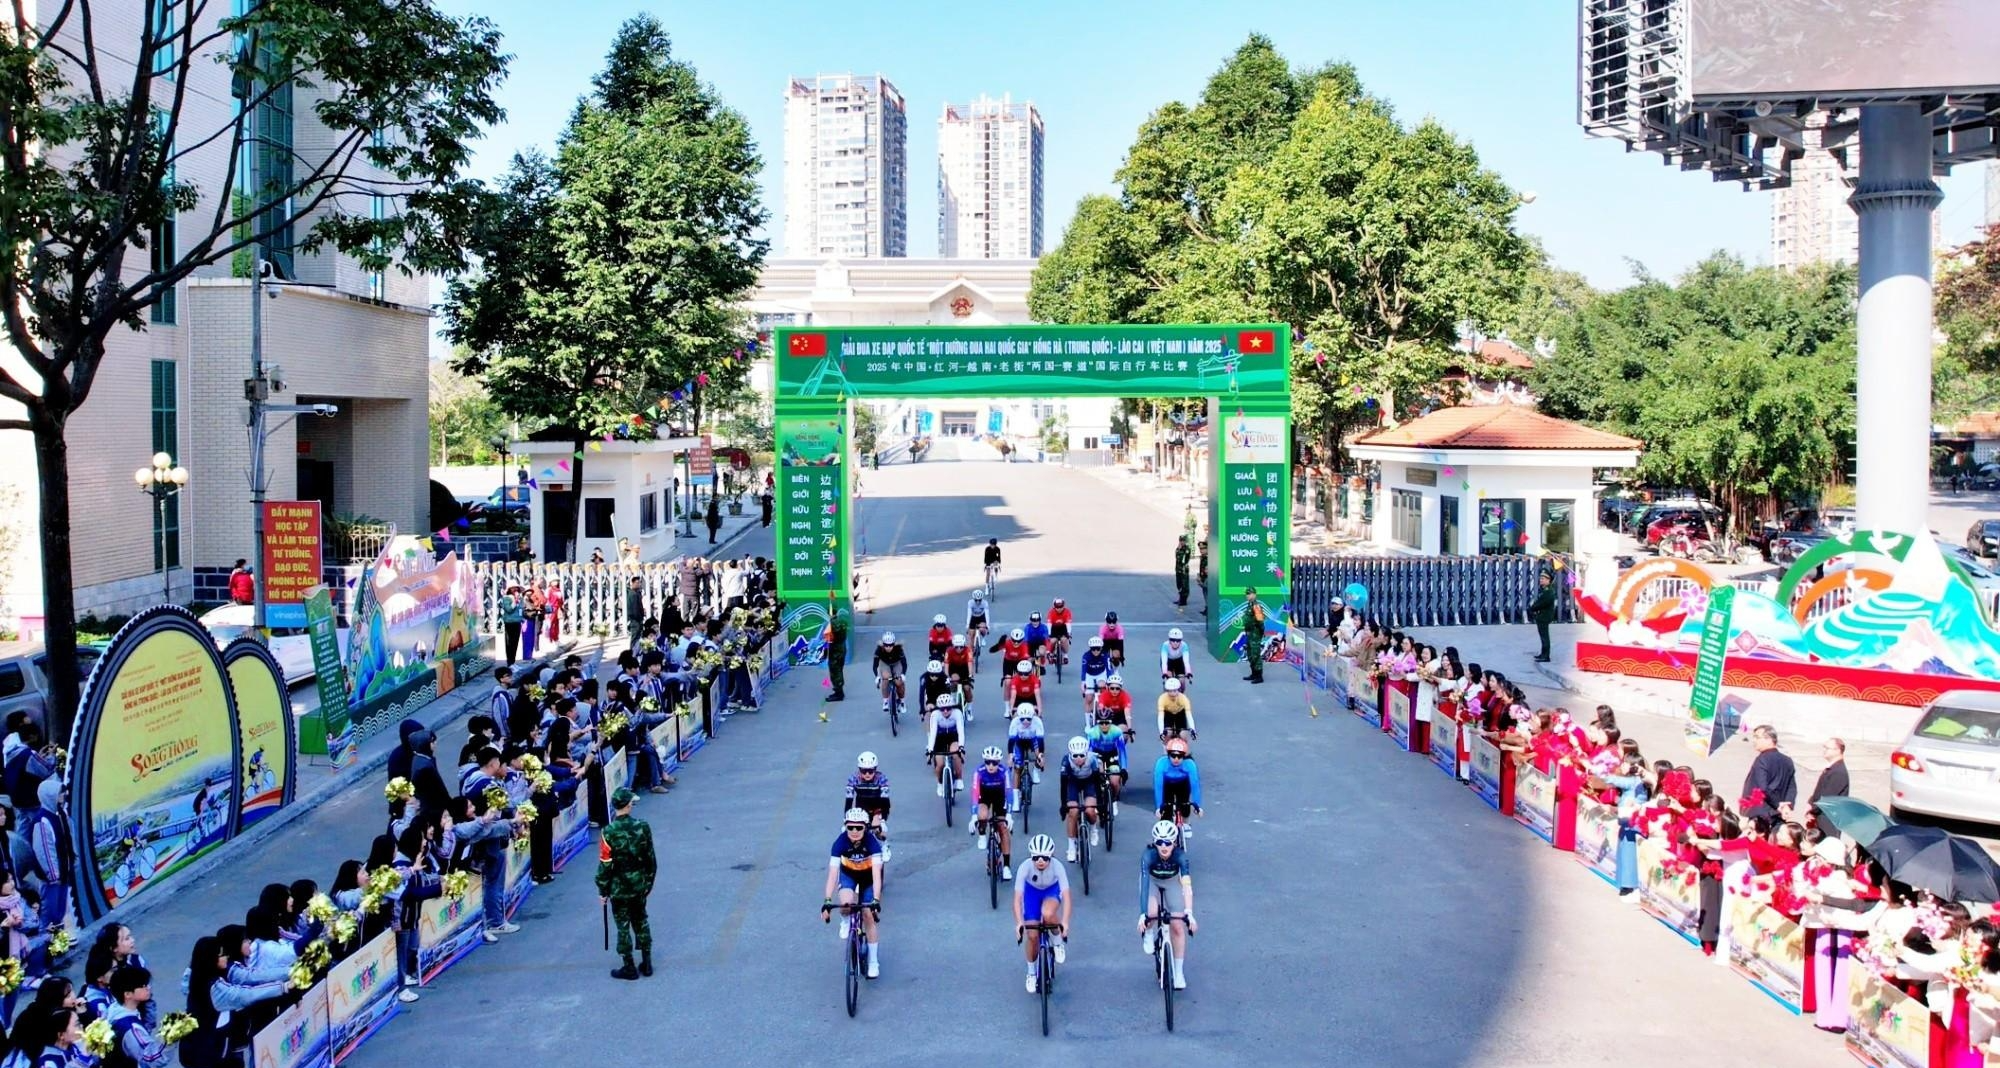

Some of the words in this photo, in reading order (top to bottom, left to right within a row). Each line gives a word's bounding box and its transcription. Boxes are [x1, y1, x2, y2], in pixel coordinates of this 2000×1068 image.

[872, 341, 881, 355] XE
[882, 341, 896, 358] ĐẠP
[897, 337, 916, 357] QUỐC
[917, 337, 926, 355] TẾ
[984, 341, 997, 355] HAI
[998, 336, 1016, 357] QUỐC
[1053, 337, 1062, 354] HÀ
[1118, 337, 1131, 354] LÀO
[1132, 340, 1144, 354] CAI
[1188, 337, 1204, 354] NĂM
[1205, 340, 1222, 354] 2025
[791, 474, 810, 483] BIÊN
[1235, 472, 1255, 480] GIAO
[792, 489, 809, 499] GIỚI
[1237, 486, 1252, 495] LƯU
[792, 504, 809, 514] HỮU
[1233, 501, 1257, 511] ĐOÀN
[288, 508, 313, 519] MẠNH
[275, 521, 292, 533] HỌC
[293, 520, 309, 533] TẬP
[791, 521, 811, 531] NGHỊ
[1237, 516, 1252, 527] KẾT
[266, 534, 278, 545] VÀ
[279, 534, 296, 545] LÀM
[297, 535, 318, 545] THEO
[789, 535, 814, 545] MUÔN
[272, 549, 283, 558] TƯ
[794, 550, 809, 560] ĐỜI
[1231, 548, 1259, 558] TƯƠNG
[275, 562, 291, 574] ĐẠO
[790, 567, 813, 577] THỊNH
[1239, 564, 1251, 573] LAI
[268, 576, 295, 586] PHONG
[297, 575, 318, 586] CÁCH
[281, 588, 295, 600] CHÍ
